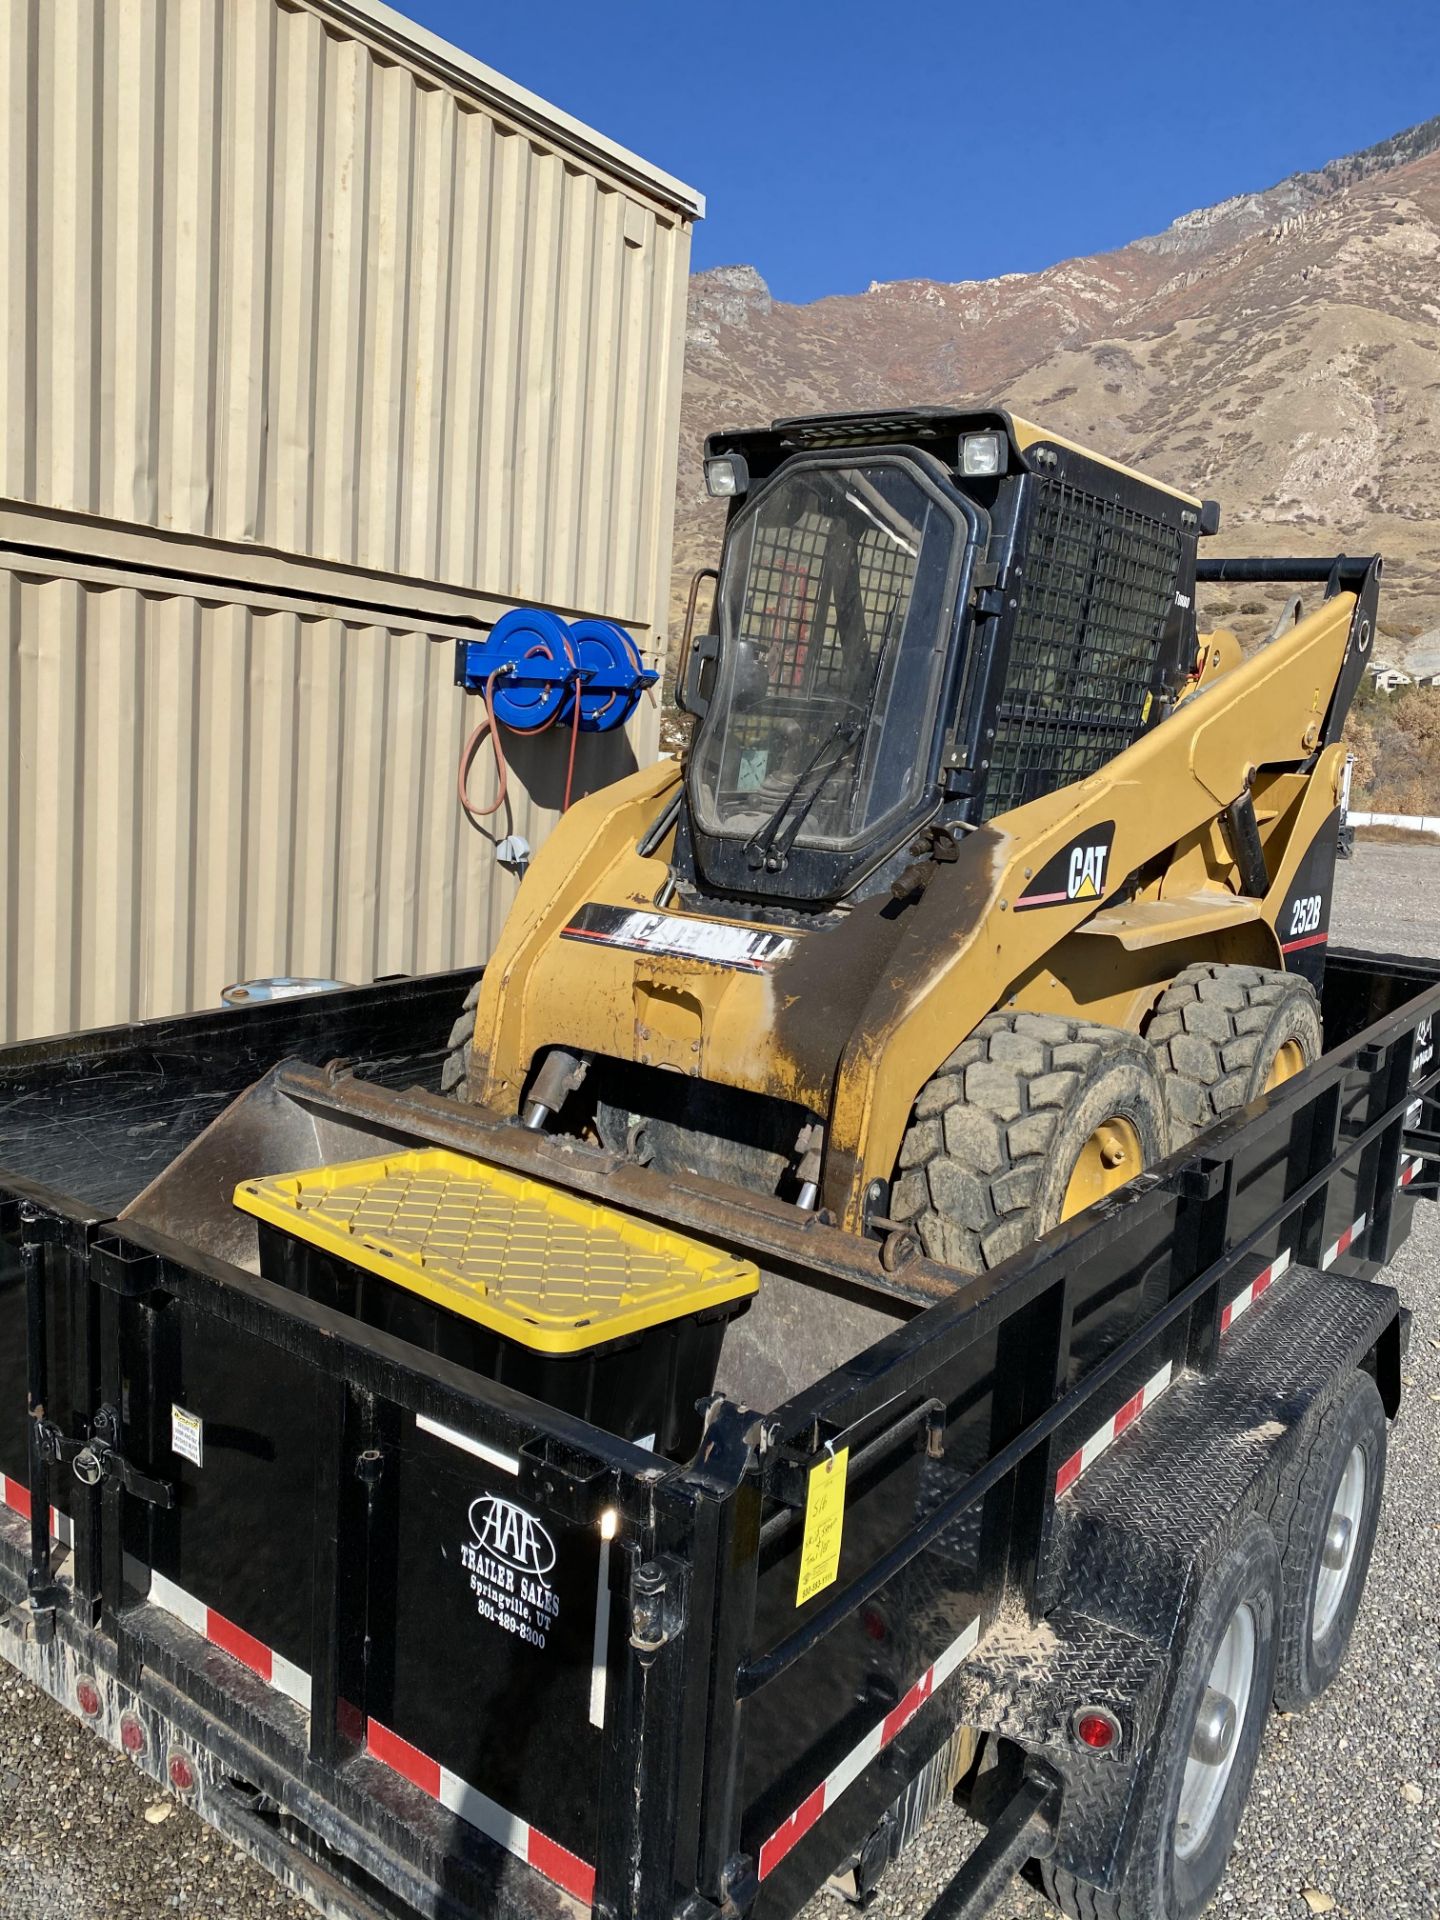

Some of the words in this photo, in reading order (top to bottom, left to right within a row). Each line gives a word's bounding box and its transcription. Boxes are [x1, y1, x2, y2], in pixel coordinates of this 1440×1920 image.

[1067, 845, 1108, 899] CAT
[1289, 894, 1322, 936] 252B
[461, 1544, 515, 1593] TRAILER
[520, 1577, 560, 1617] SALES
[469, 1574, 532, 1624] Springville,
[536, 1611, 551, 1631] UT
[477, 1599, 546, 1650] 801-489-8300
